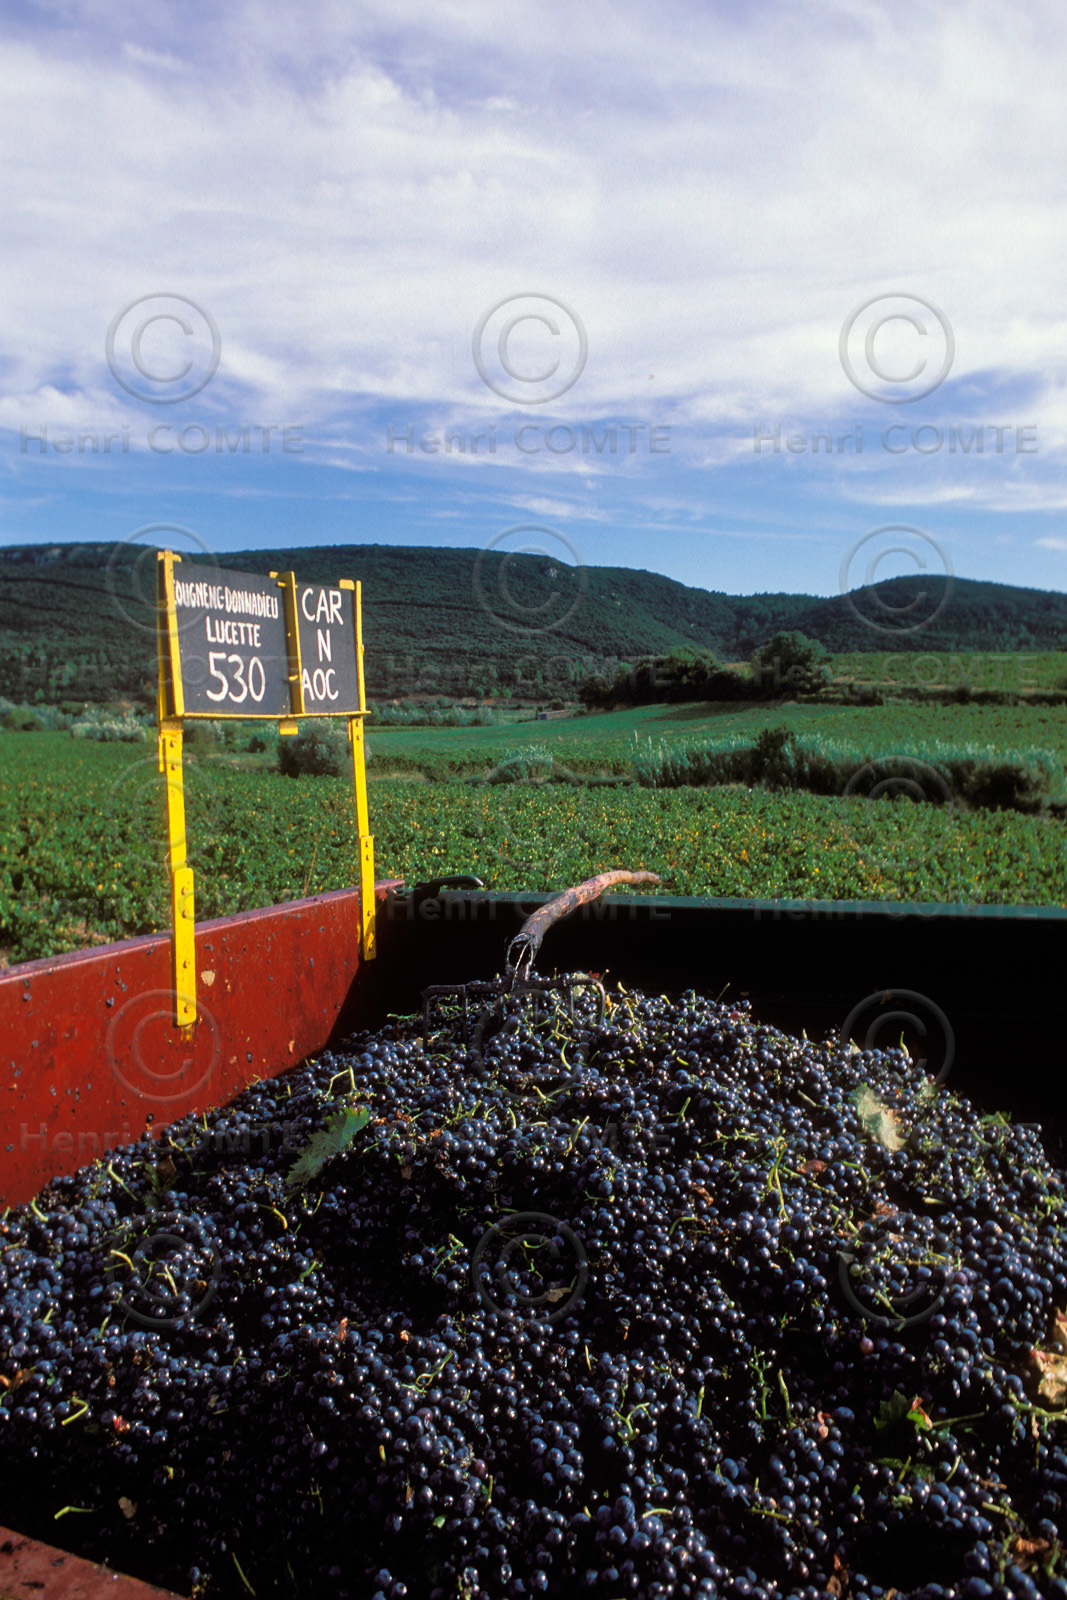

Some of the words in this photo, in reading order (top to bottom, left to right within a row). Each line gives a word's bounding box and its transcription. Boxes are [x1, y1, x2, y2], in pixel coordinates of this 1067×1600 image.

[302, 588, 344, 625] CAR
[206, 616, 261, 648] LUCETTE
[317, 628, 332, 662] N
[206, 651, 266, 703] 530
[301, 668, 339, 700] AOC
